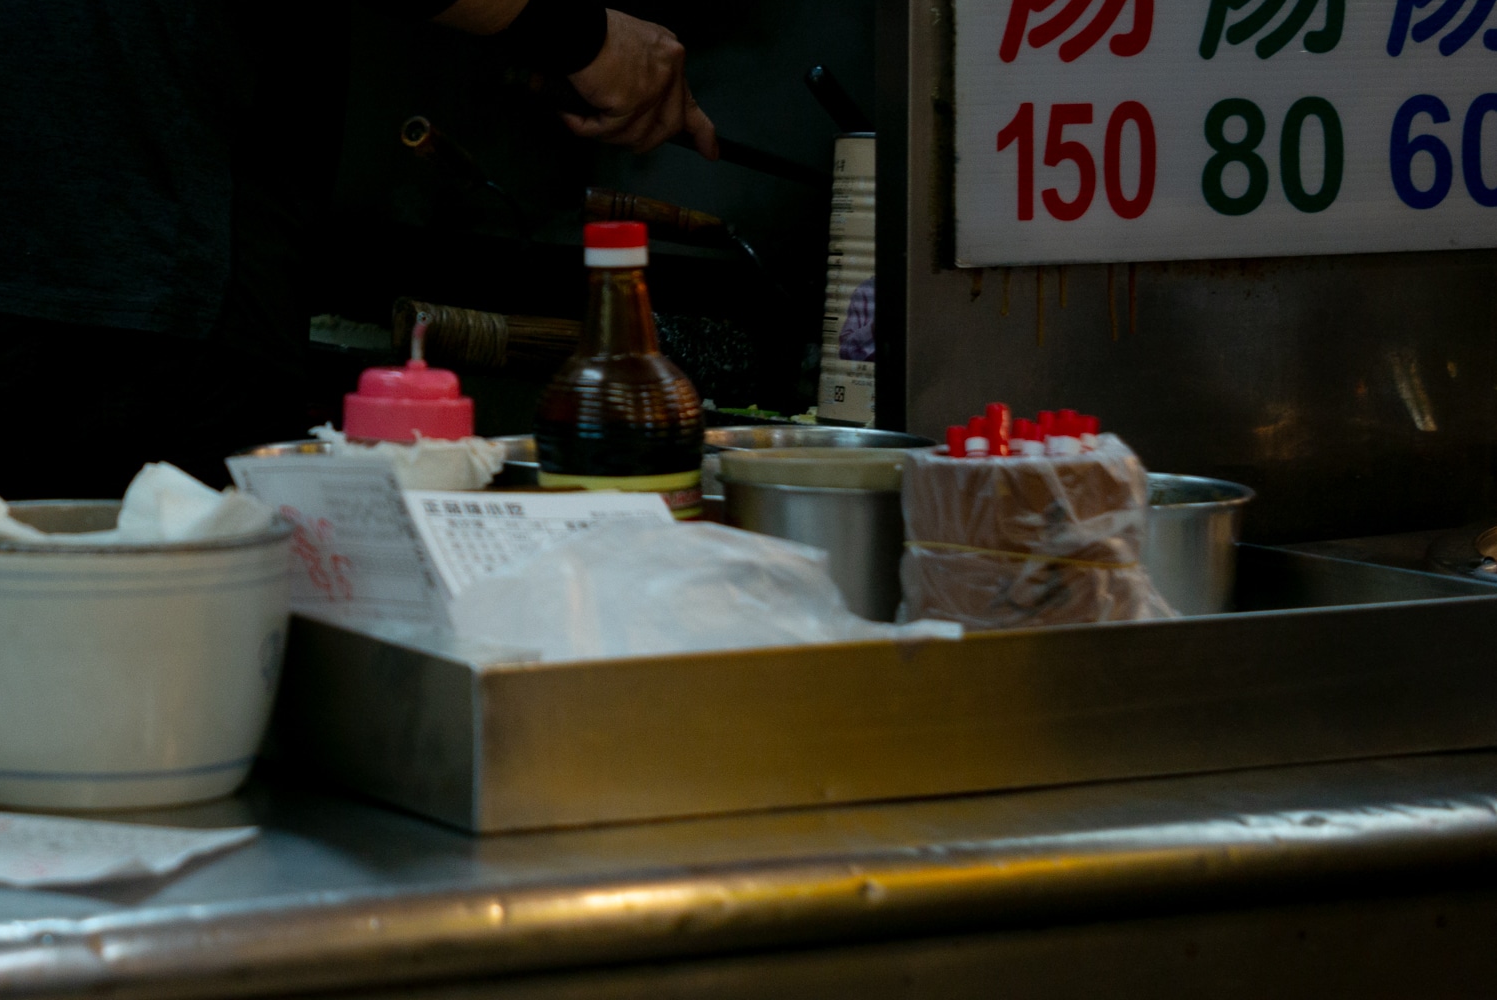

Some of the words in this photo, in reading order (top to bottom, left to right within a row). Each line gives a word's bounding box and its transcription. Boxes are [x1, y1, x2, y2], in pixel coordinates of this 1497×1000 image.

[996, 100, 1156, 221] 150
[1201, 97, 1343, 216] 80
[1389, 94, 1497, 210] 60
